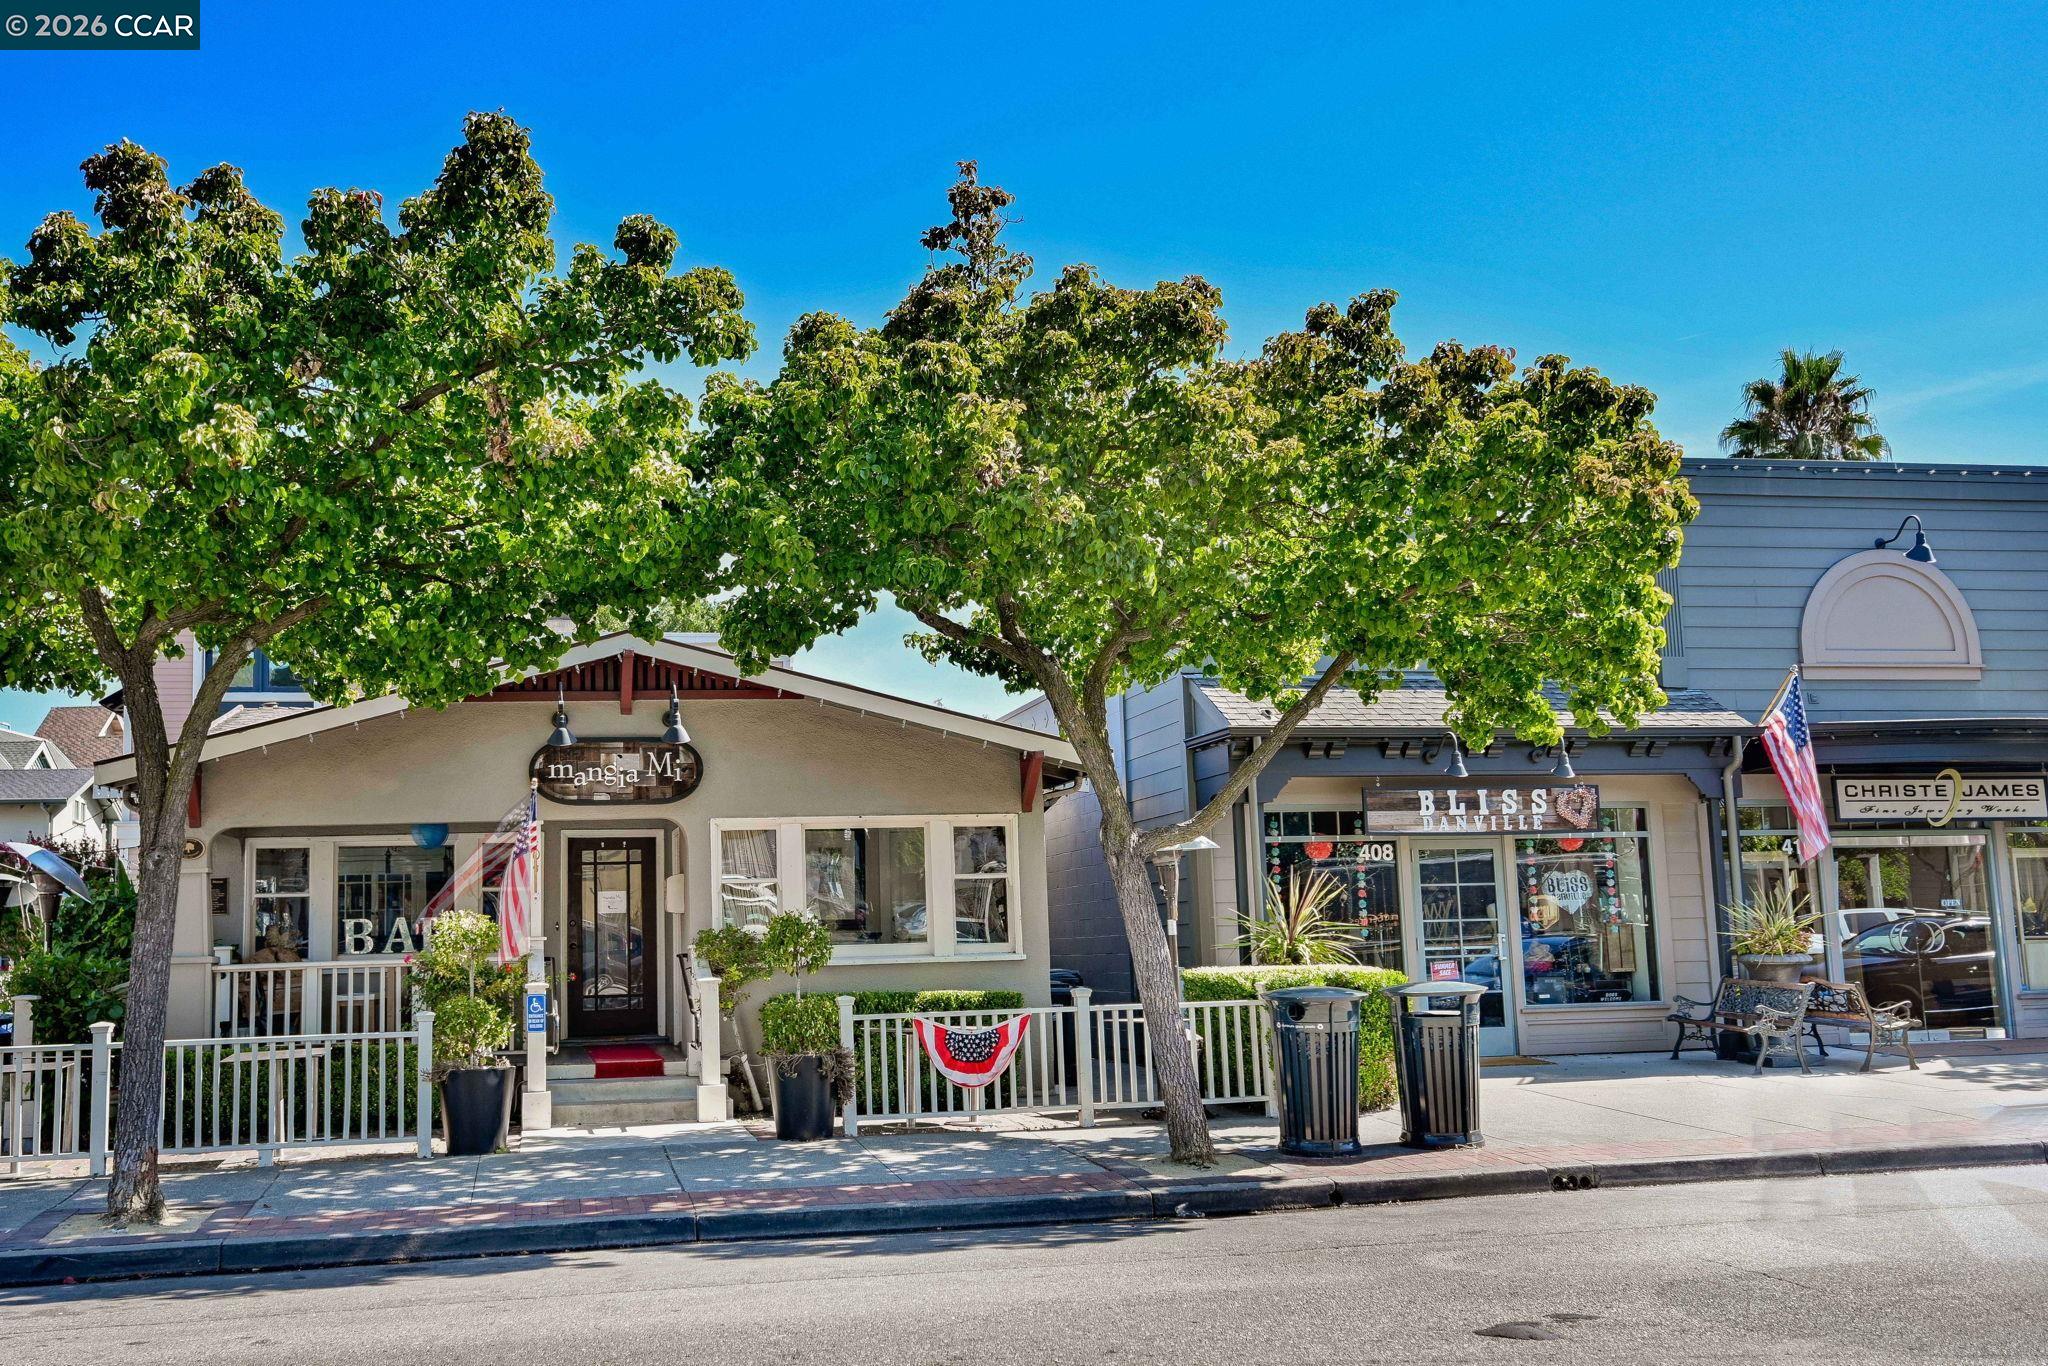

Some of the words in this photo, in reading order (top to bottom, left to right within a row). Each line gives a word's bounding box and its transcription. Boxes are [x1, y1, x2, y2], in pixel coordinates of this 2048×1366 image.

[548, 762, 640, 788] mangia
[647, 752, 682, 782] Mi
[1844, 785, 1948, 798] CHRISTE
[1962, 784, 2040, 797] JAMES
[1417, 788, 1548, 816] BLISS
[1859, 805, 1898, 814] Fine
[1904, 805, 1973, 816] Jewery
[1980, 804, 2027, 813] Works
[1422, 815, 1544, 831] DANVILLE
[1359, 844, 1394, 861] 408
[1782, 839, 1801, 855] 41
[1940, 899, 1961, 907] OPEN
